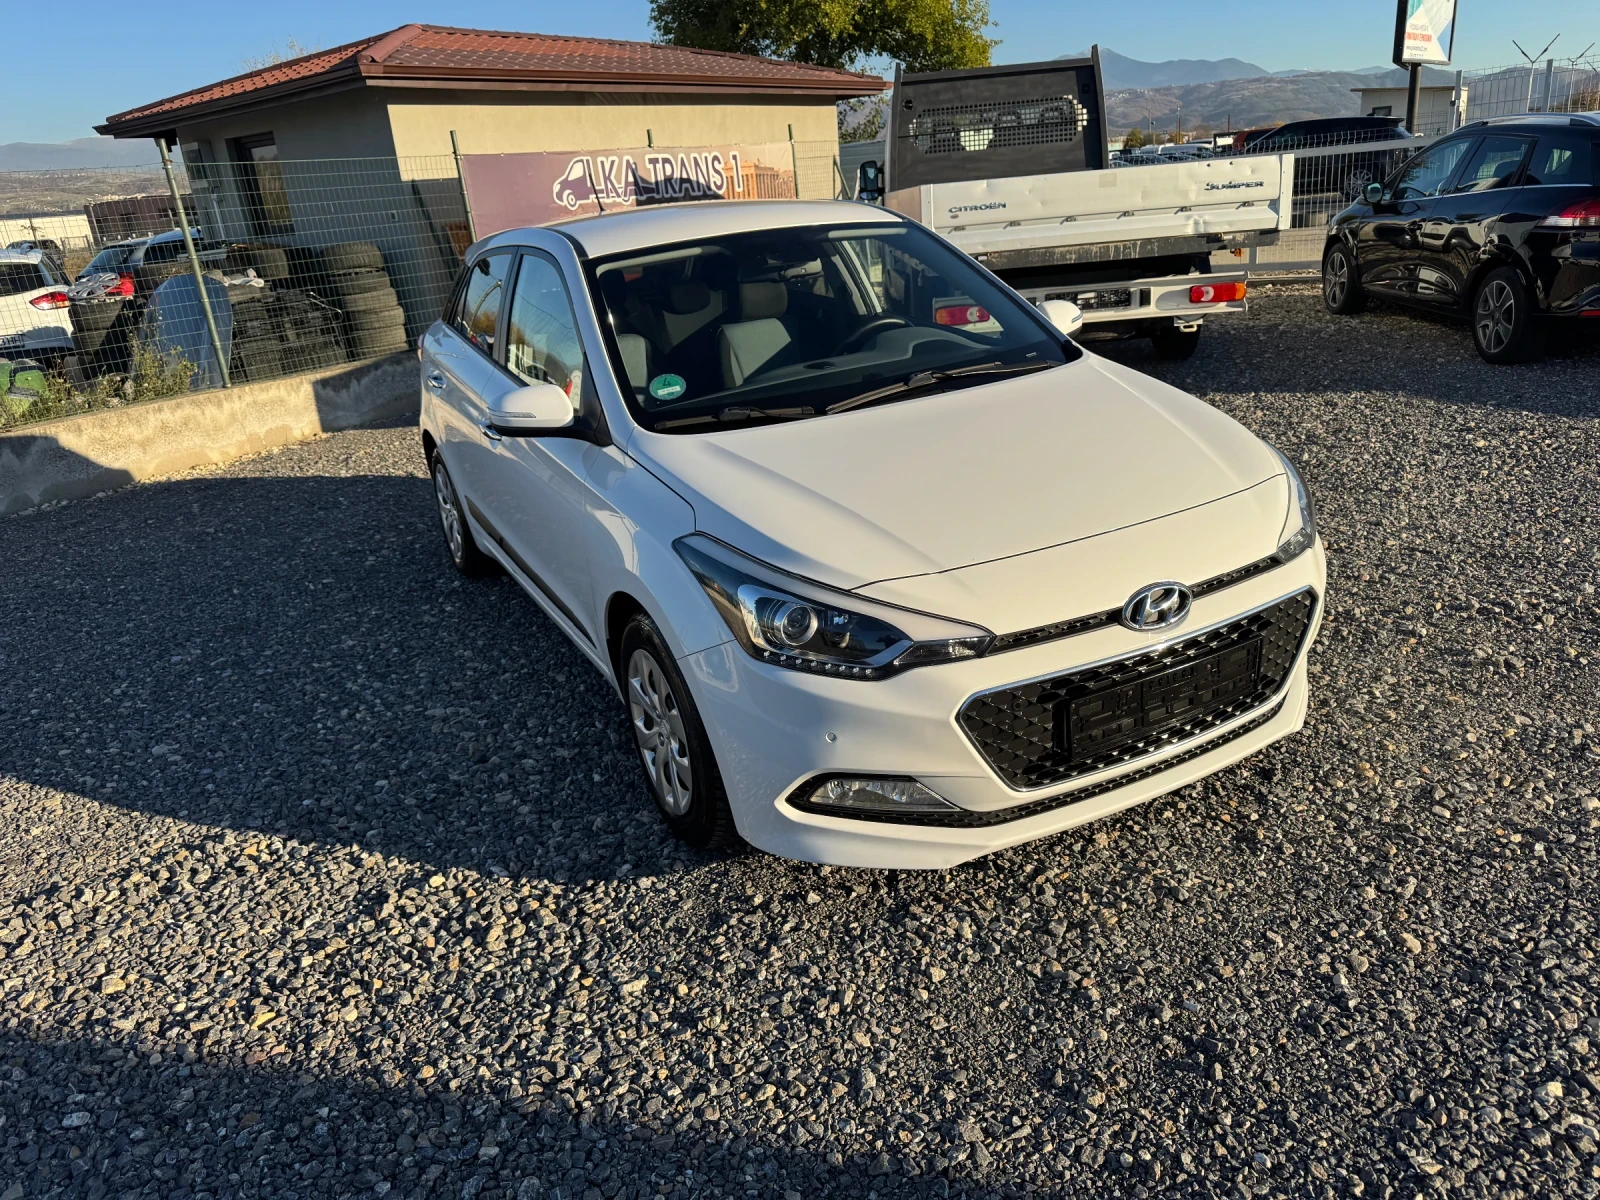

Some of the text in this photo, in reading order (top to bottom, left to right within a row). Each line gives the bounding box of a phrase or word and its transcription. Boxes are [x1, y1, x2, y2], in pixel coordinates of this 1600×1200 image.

[645, 151, 727, 197] TRANS
[730, 150, 743, 192] 1
[1203, 180, 1265, 191] JUMPER
[948, 201, 1007, 214] CITROËN
[662, 377, 671, 387] 4
